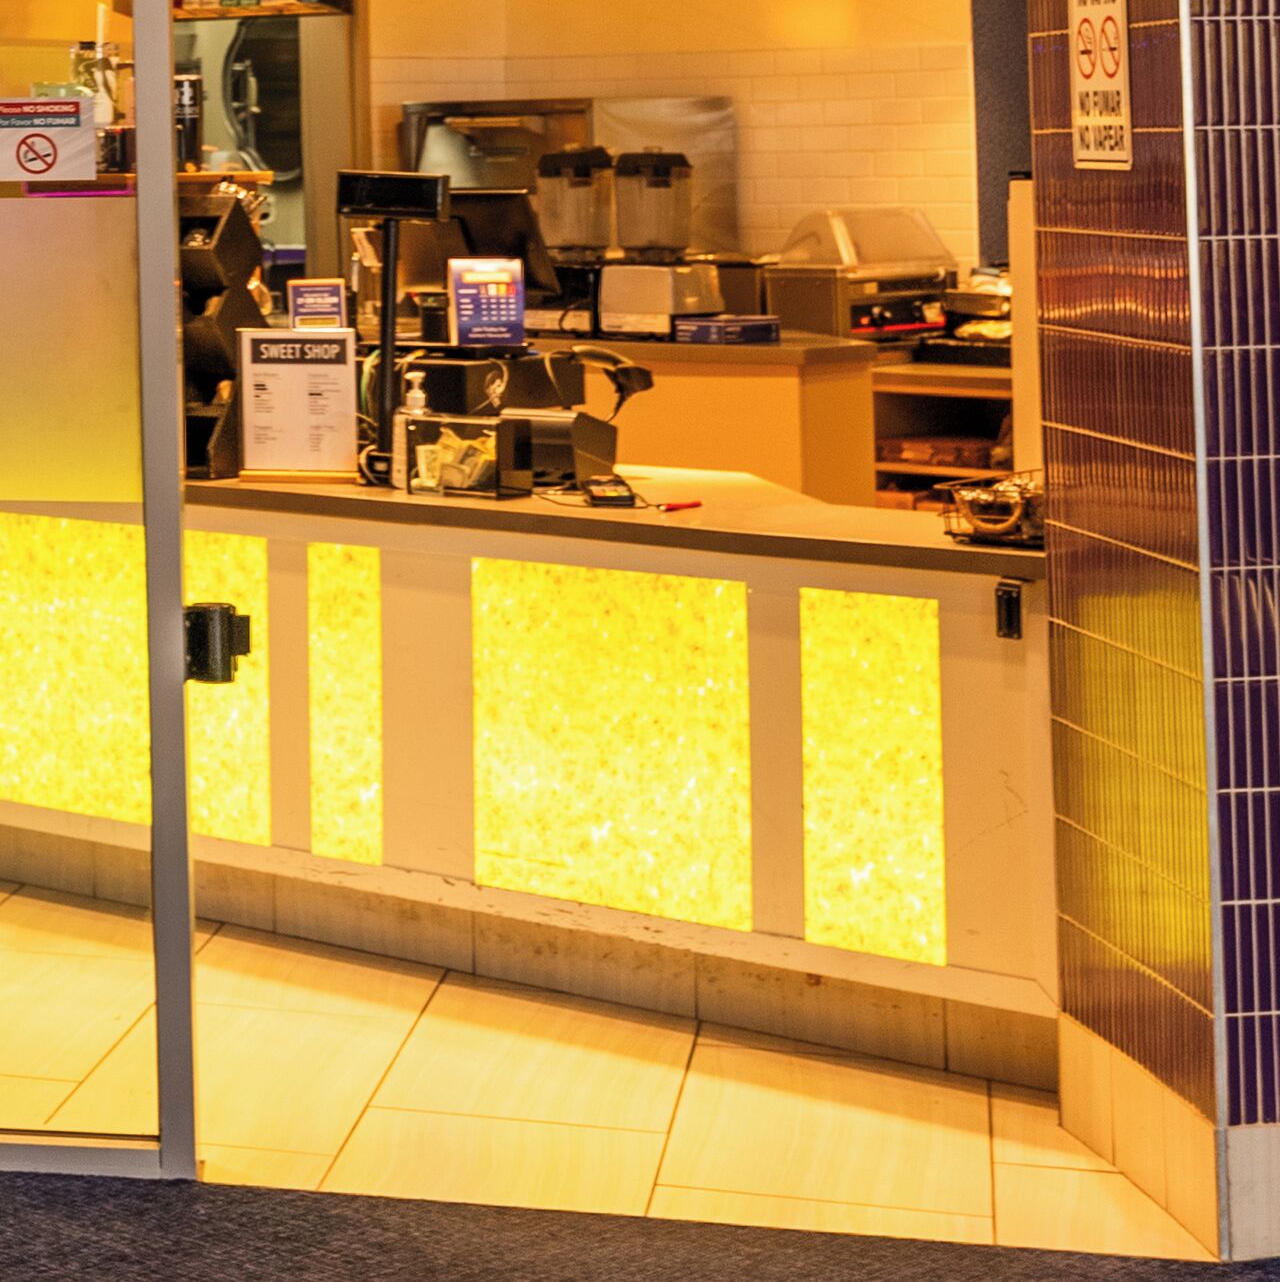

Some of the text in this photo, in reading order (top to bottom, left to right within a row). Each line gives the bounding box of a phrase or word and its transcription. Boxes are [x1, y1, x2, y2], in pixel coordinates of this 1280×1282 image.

[22, 105, 35, 113] NO
[36, 104, 76, 113] SMOKING
[1079, 89, 1122, 117] NO FUMAR
[10, 118, 32, 126] Favor
[33, 118, 45, 126] NO
[1079, 124, 1125, 151] NO VAPEAR
[260, 343, 340, 359] SWEET SHOP
